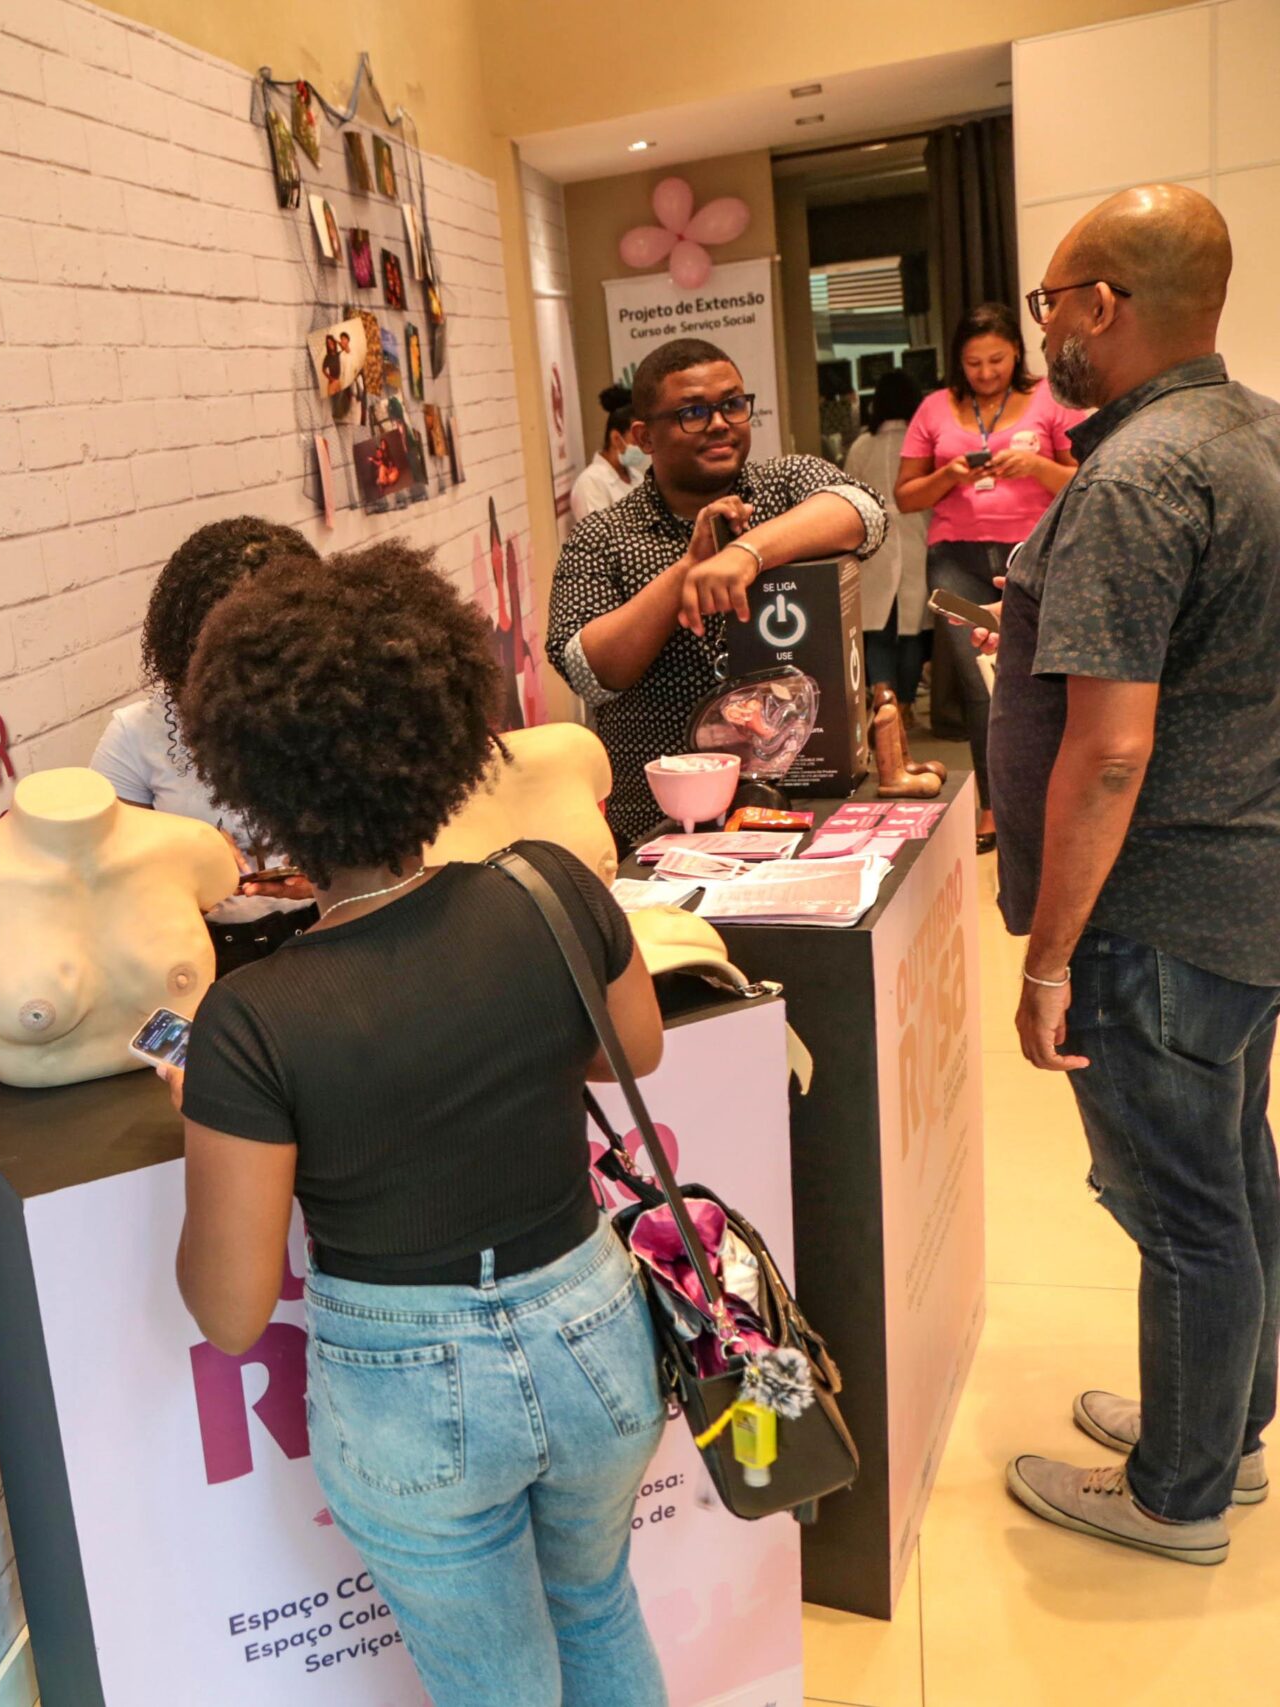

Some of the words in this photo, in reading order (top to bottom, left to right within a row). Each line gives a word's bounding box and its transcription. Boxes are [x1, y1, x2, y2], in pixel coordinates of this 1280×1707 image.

[619, 306, 673, 323] Projeto
[676, 301, 693, 314] de
[696, 292, 765, 313] Extensão
[630, 327, 662, 339] Curso
[664, 325, 677, 334] de
[680, 319, 721, 333] Serviço
[723, 313, 756, 327] Social
[763, 583, 775, 592] SE
[776, 582, 797, 591] LIGA
[776, 651, 793, 660] USE
[635, 1473, 685, 1500] osa:
[650, 1505, 676, 1524] de
[228, 1591, 330, 1636] Espaço
[244, 1623, 333, 1663] Espaço
[305, 1630, 403, 1673] Serviços
